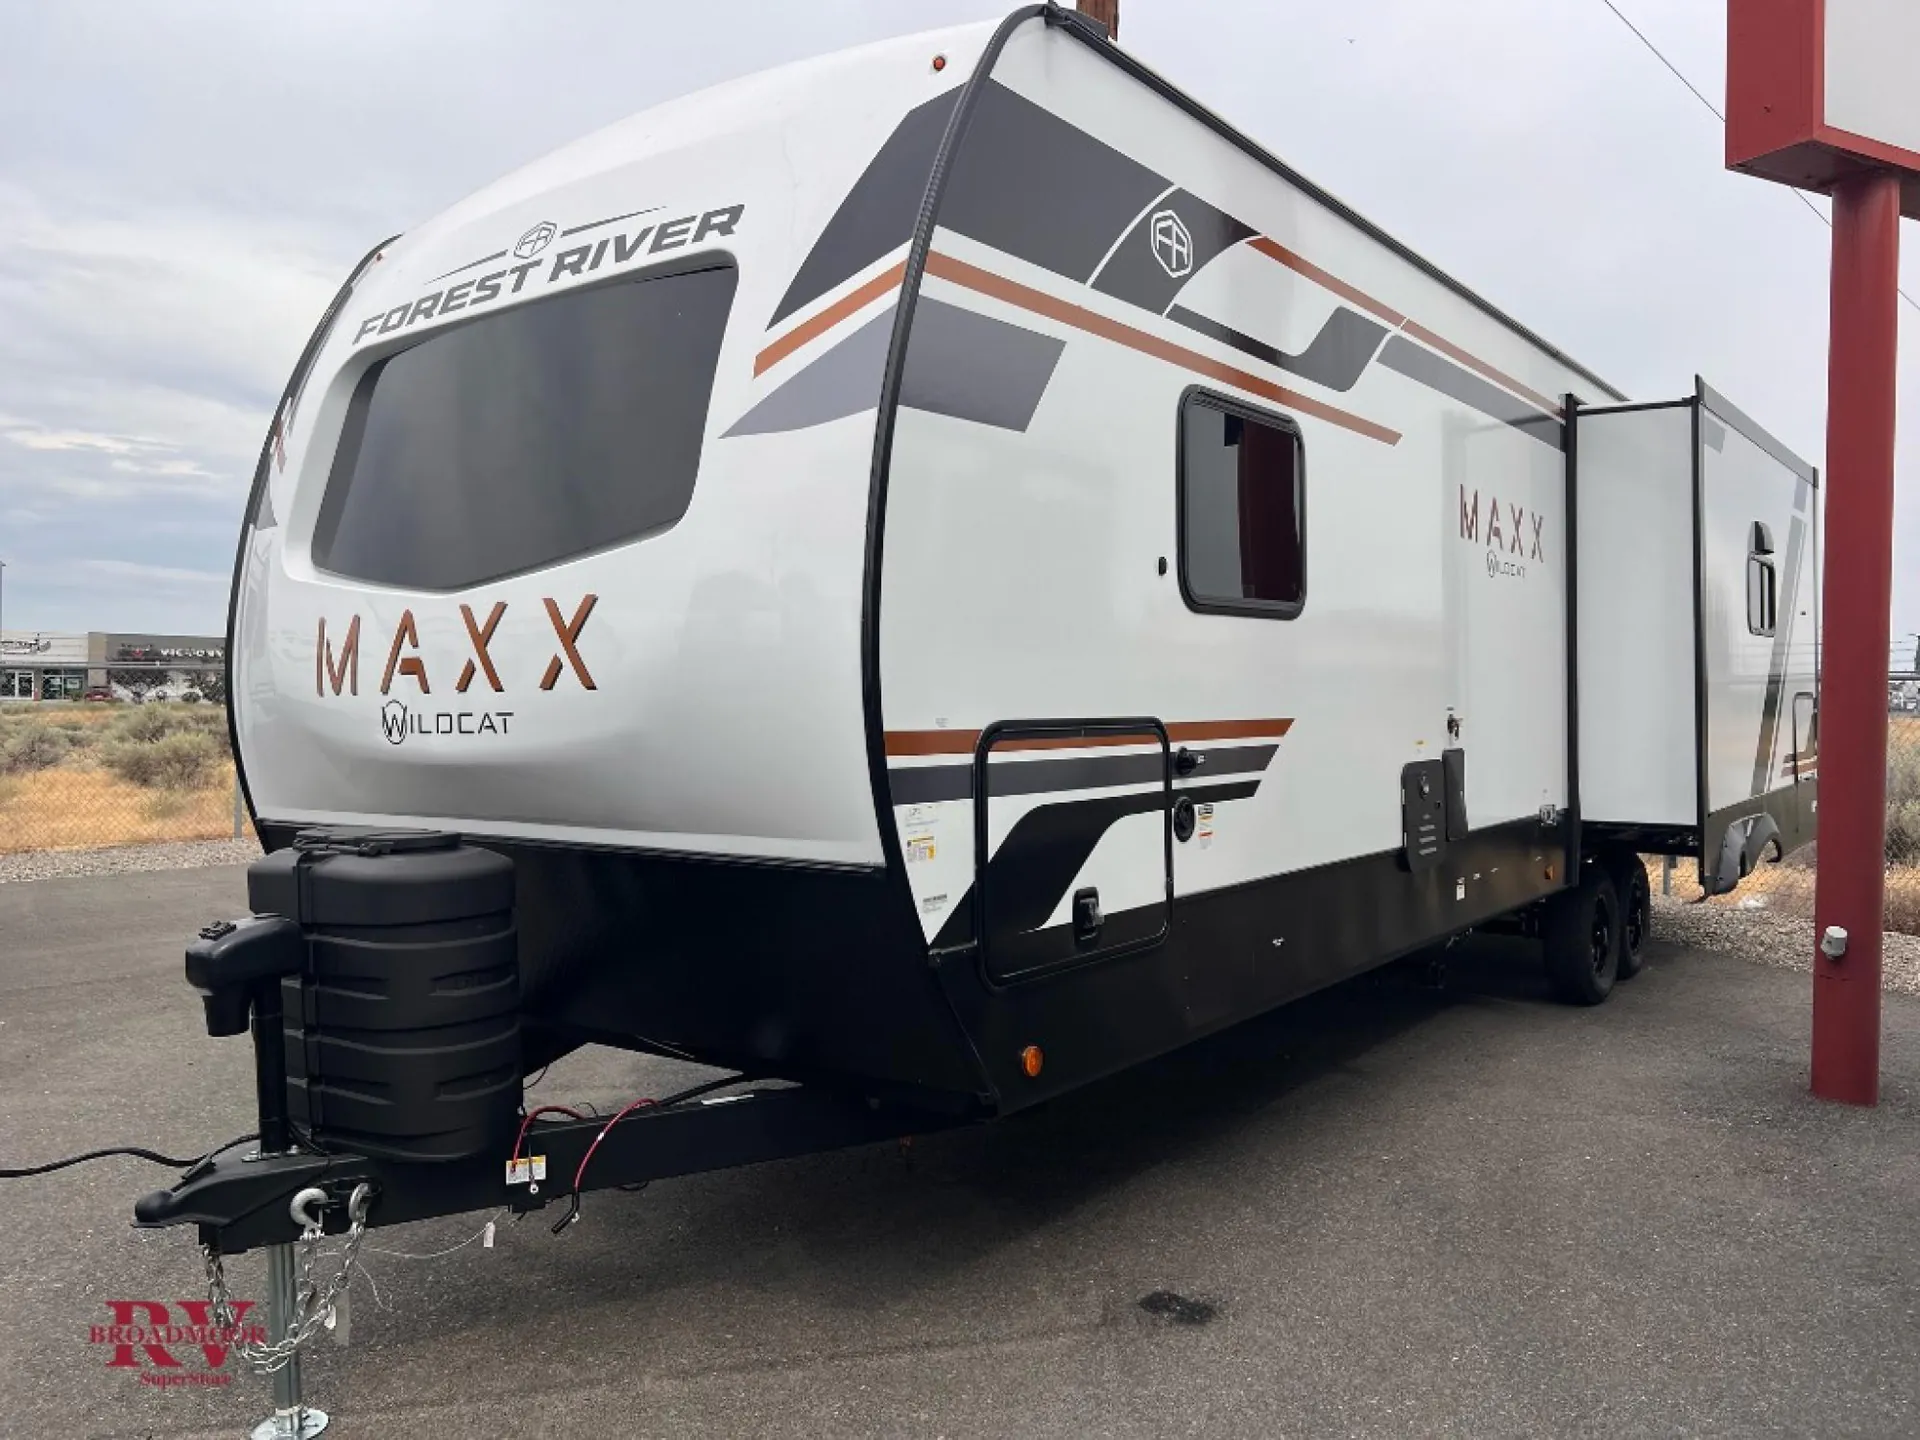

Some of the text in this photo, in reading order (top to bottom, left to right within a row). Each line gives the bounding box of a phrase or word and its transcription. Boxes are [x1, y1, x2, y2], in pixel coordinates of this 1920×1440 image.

[352, 203, 745, 345] FOREST RIVER
[1460, 483, 1544, 564] MAXX
[316, 593, 599, 697] MAXX
[381, 699, 515, 745] WILDCAT
